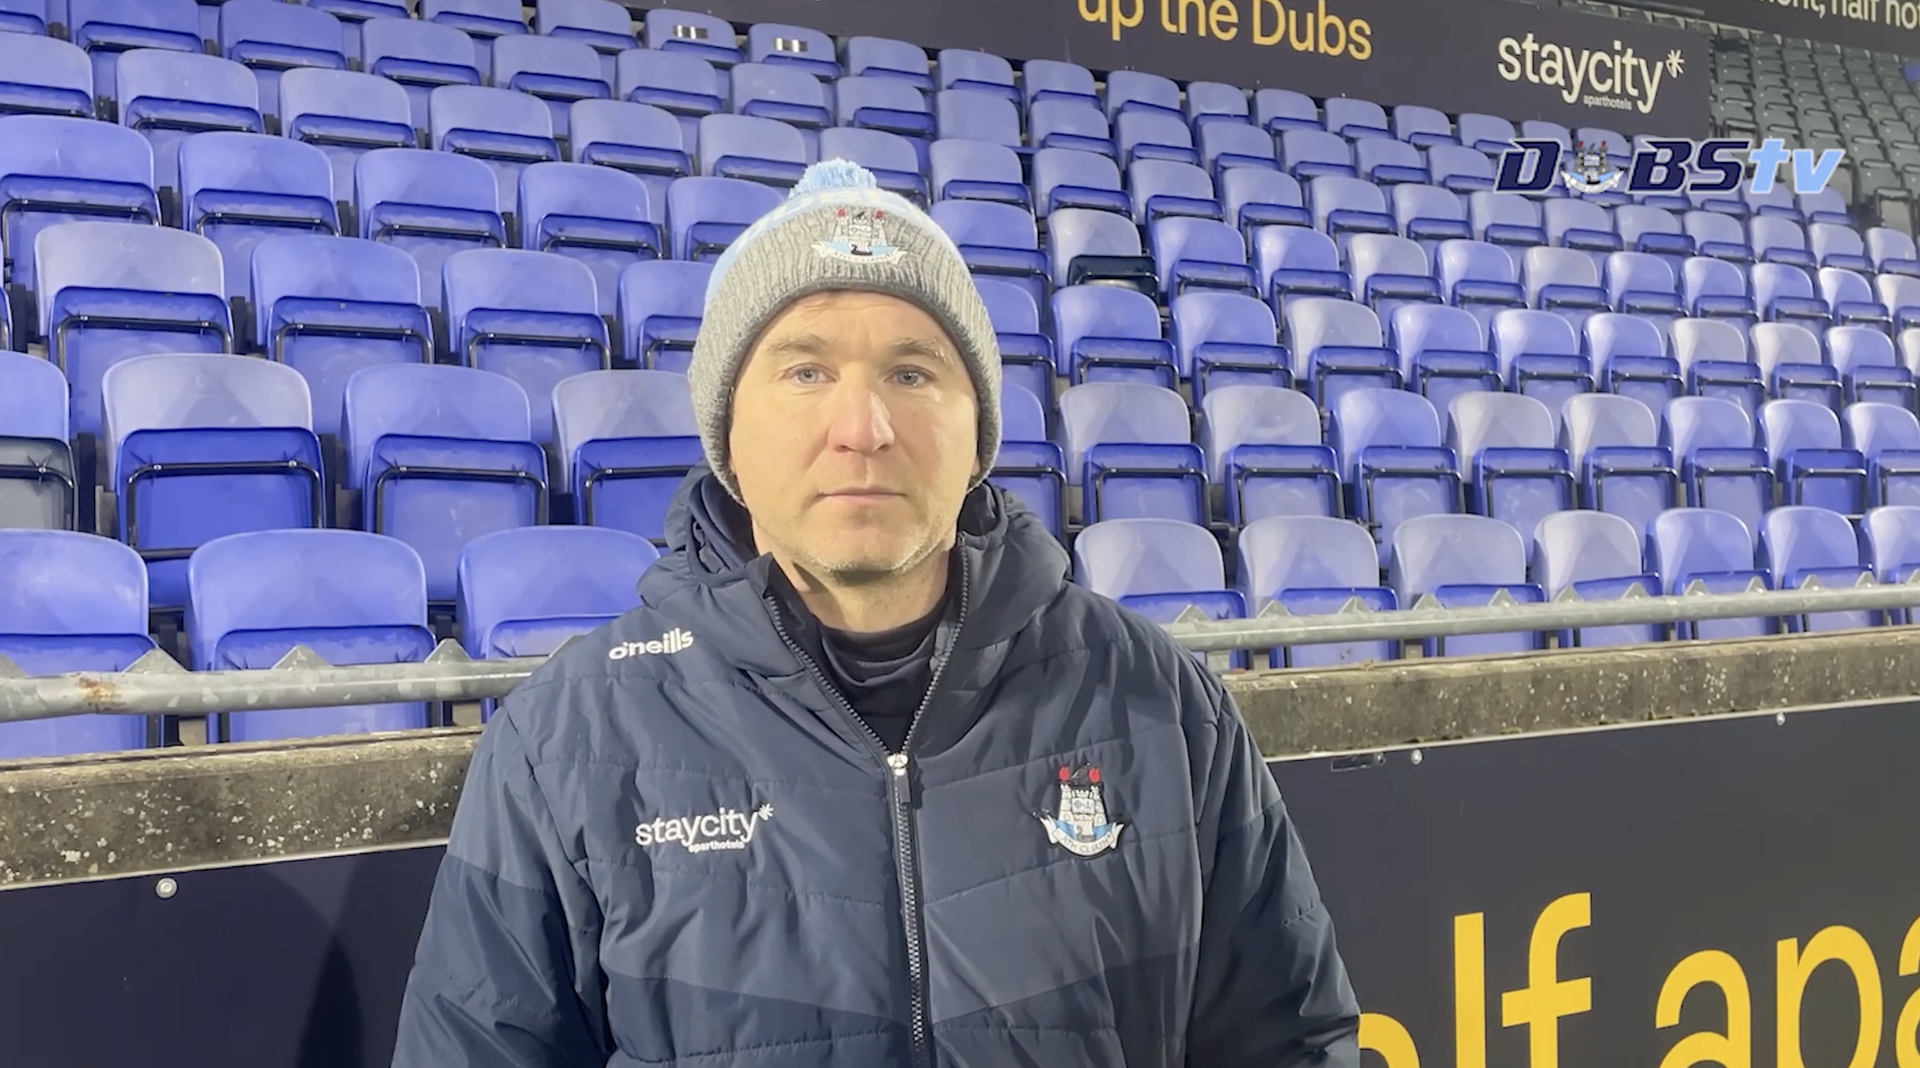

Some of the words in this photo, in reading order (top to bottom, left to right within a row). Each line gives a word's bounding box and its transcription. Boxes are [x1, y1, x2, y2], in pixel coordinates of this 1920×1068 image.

[1078, 0, 1144, 41] up
[1160, 0, 1239, 41] the
[1253, 0, 1372, 60] Dubs
[1583, 94, 1632, 110] aparthotels
[608, 627, 694, 660] o'neills
